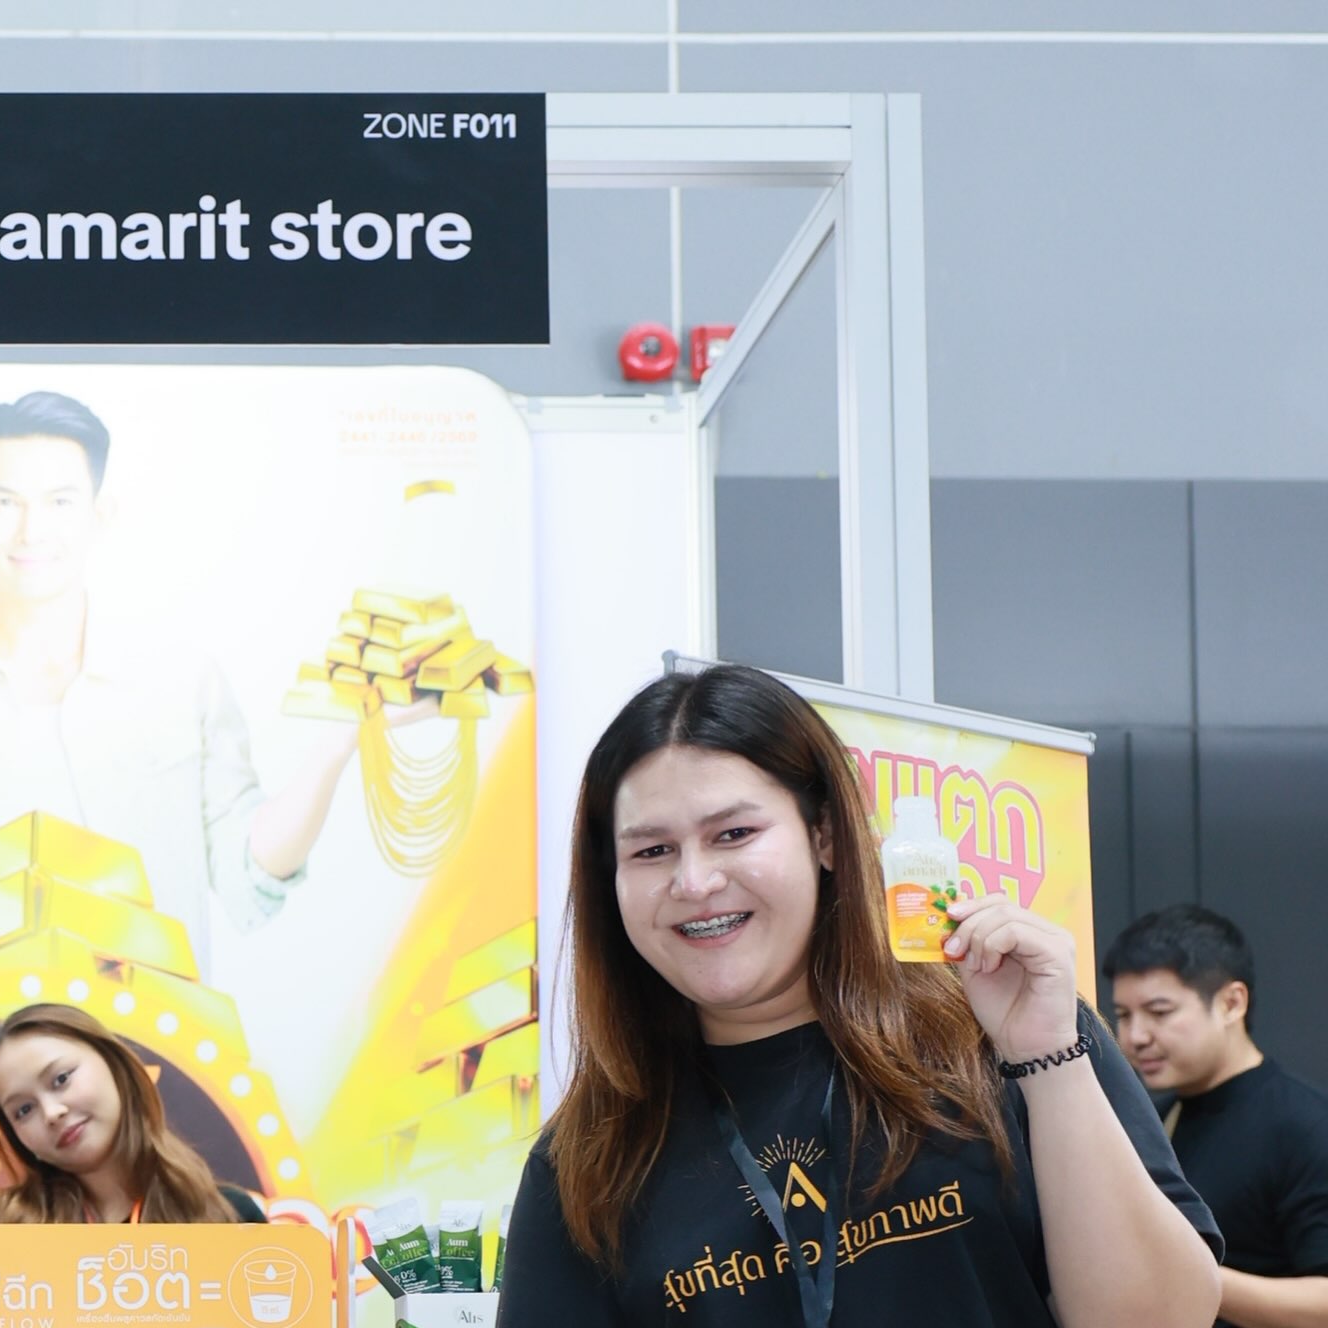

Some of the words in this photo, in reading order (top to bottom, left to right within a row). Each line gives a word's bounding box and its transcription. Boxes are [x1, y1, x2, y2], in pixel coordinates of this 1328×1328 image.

[363, 114, 446, 138] ZONE
[453, 114, 517, 138] F011
[270, 199, 473, 260] store
